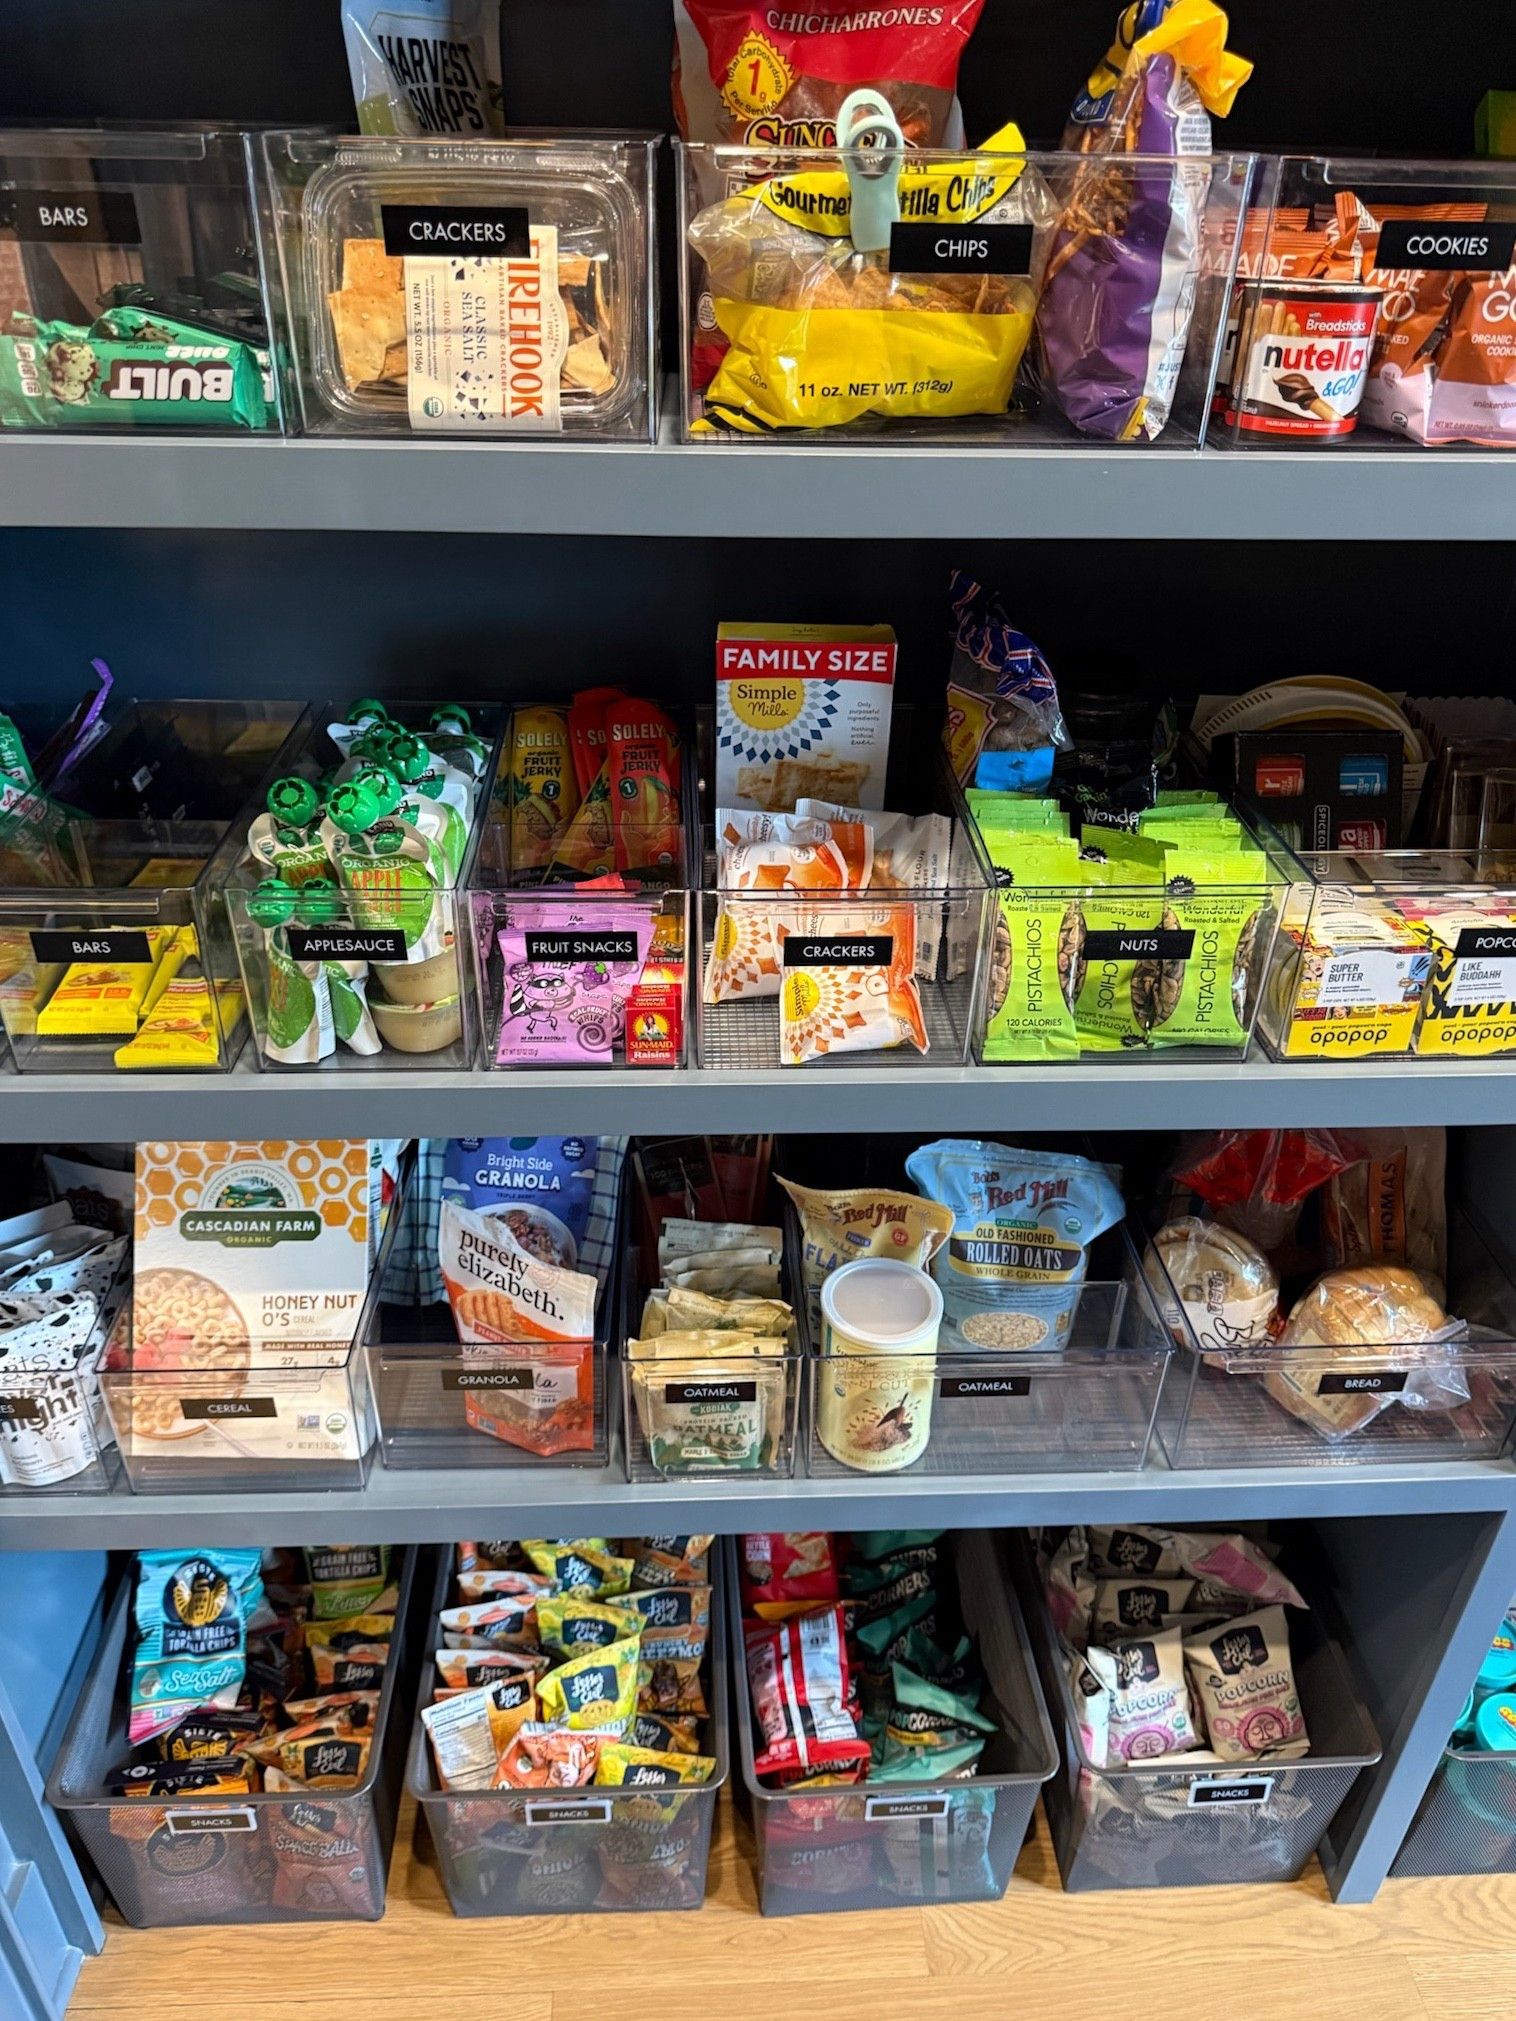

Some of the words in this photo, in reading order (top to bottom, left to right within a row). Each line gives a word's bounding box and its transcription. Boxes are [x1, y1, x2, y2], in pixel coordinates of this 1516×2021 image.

[766, 7, 944, 34] CHICHARRONES
[377, 35, 482, 91] HARVEST
[740, 46, 783, 95] Carbohydrate
[748, 58, 762, 96] 1
[730, 90, 744, 108] Per
[408, 87, 485, 133] SNAPS
[946, 175, 997, 213] Chips
[39, 206, 89, 227] BARS
[409, 221, 507, 243] CRACKERS
[934, 239, 990, 259] CHIPS
[1406, 236, 1489, 257] COOKIES
[412, 282, 422, 301] NET
[498, 265, 506, 305] ARTISAN
[413, 302, 422, 319] WT.
[461, 291, 474, 321] SEA
[413, 320, 423, 335] 5.5
[442, 300, 453, 357] ORGANIC
[475, 296, 488, 361] CLASSIC
[546, 320, 556, 341] 1992
[1306, 319, 1367, 332] Breadsticks
[415, 334, 424, 348] OZ
[462, 324, 475, 364] SALT
[1471, 334, 1513, 345] ORGANIC
[413, 348, 425, 374] (156g)
[1263, 341, 1364, 372] nutella
[499, 343, 508, 393] CRACKERS
[109, 366, 234, 402] BUILT
[799, 384, 817, 397] 11
[821, 386, 844, 398] oz.
[848, 382, 881, 397] NET
[884, 381, 910, 396] WT.
[912, 380, 954, 396] (312g)
[1322, 370, 1362, 398] &GO!
[723, 647, 823, 670] FAMILY
[827, 650, 889, 673] SIZE
[737, 684, 798, 704] Simple
[849, 708, 881, 716] purposeful
[857, 701, 872, 709] Only
[516, 732, 568, 748] SOLELY
[612, 723, 664, 742] SOLELY
[523, 756, 562, 766] FRUIT
[621, 750, 660, 760] FRUIT
[521, 766, 563, 779] JERKY
[620, 760, 661, 774] JERKY
[1083, 807, 1139, 824] Wonde
[1317, 807, 1326, 872] SPICEOLGY
[341, 857, 411, 869] ORGANIC
[913, 849, 926, 882] FLOUR
[351, 868, 402, 890] APPLE
[1184, 916, 1209, 924] Roasted
[1218, 916, 1240, 925] Salted
[72, 941, 112, 954] BARS
[303, 939, 396, 951] APPLESAUCE
[532, 941, 571, 954] FRUIT
[573, 941, 634, 954] SNACKS
[803, 945, 876, 958] CRACKERS
[1119, 939, 1159, 952] NUTS
[1026, 918, 1043, 1013] PISTACHIOS
[1330, 963, 1360, 973] SUPER
[1462, 961, 1483, 972] LIKE
[1194, 929, 1220, 1023] PISTACHIOS
[1328, 972, 1364, 983] BUTTER
[1460, 970, 1502, 981] BUDDAHH
[793, 977, 804, 1017] Simple
[576, 1013, 605, 1026] WHIPS
[586, 1006, 609, 1016] FRUIT
[1005, 1018, 1021, 1027] 120
[1021, 1018, 1063, 1027] CALORIES
[1310, 1028, 1390, 1047] opopop
[633, 1050, 671, 1059] Raisins
[487, 1153, 525, 1171] Bright
[526, 1156, 554, 1171] Side
[475, 1169, 562, 1191] GRANOLA
[986, 1180, 1027, 1215] Red
[1026, 1178, 1069, 1210] Mill
[842, 1202, 875, 1226] Red
[871, 1203, 910, 1229] Mill
[1381, 1162, 1398, 1255] THOMAS
[186, 1220, 271, 1232] CASCADIAN
[276, 1220, 316, 1232] FARM
[996, 1219, 1037, 1229] ORGANIC
[226, 1235, 273, 1244] ORGANIC
[976, 1227, 994, 1239] OLD
[997, 1228, 1055, 1245] FASHIONED
[459, 1229, 530, 1281] purely
[966, 1242, 1020, 1265] ROLLED
[1024, 1247, 1063, 1270] OATS
[976, 1266, 1014, 1277] WHOLE
[1016, 1269, 1051, 1281] GRAIN
[457, 1252, 566, 1321] elizabeth.
[262, 1295, 320, 1310] HONEY
[324, 1294, 358, 1310] NUT
[262, 1312, 290, 1327] O'S
[293, 1314, 316, 1324] CEREAL
[264, 1342, 286, 1350] MADE
[287, 1342, 306, 1350] WITH
[457, 1375, 520, 1385] GRANOLA
[958, 1381, 1014, 1392] OATMEAL
[1344, 1378, 1382, 1389] BREAD
[683, 1387, 740, 1398] OATMEAL
[207, 1403, 253, 1414] CEREAL
[700, 1403, 732, 1414] KODIAK
[673, 1419, 757, 1437] OATMEAL
[745, 1540, 772, 1549] KETTLE
[745, 1549, 772, 1562] CORN
[183, 1563, 217, 1583] SIETE
[314, 1565, 351, 1579] TORTILLA
[352, 1562, 378, 1576] CHIPS
[203, 1627, 226, 1639] FREE
[207, 1636, 237, 1651] CHIPS
[165, 1668, 202, 1692] Sea
[200, 1665, 238, 1692] Salt
[1214, 1670, 1290, 1704] POPCORN
[183, 1728, 222, 1742] SIETE
[1210, 1788, 1251, 1799] SNACKS
[549, 1810, 590, 1819] SNACKS
[889, 1804, 929, 1814] SNACKS
[190, 1817, 233, 1827] SNACKS
